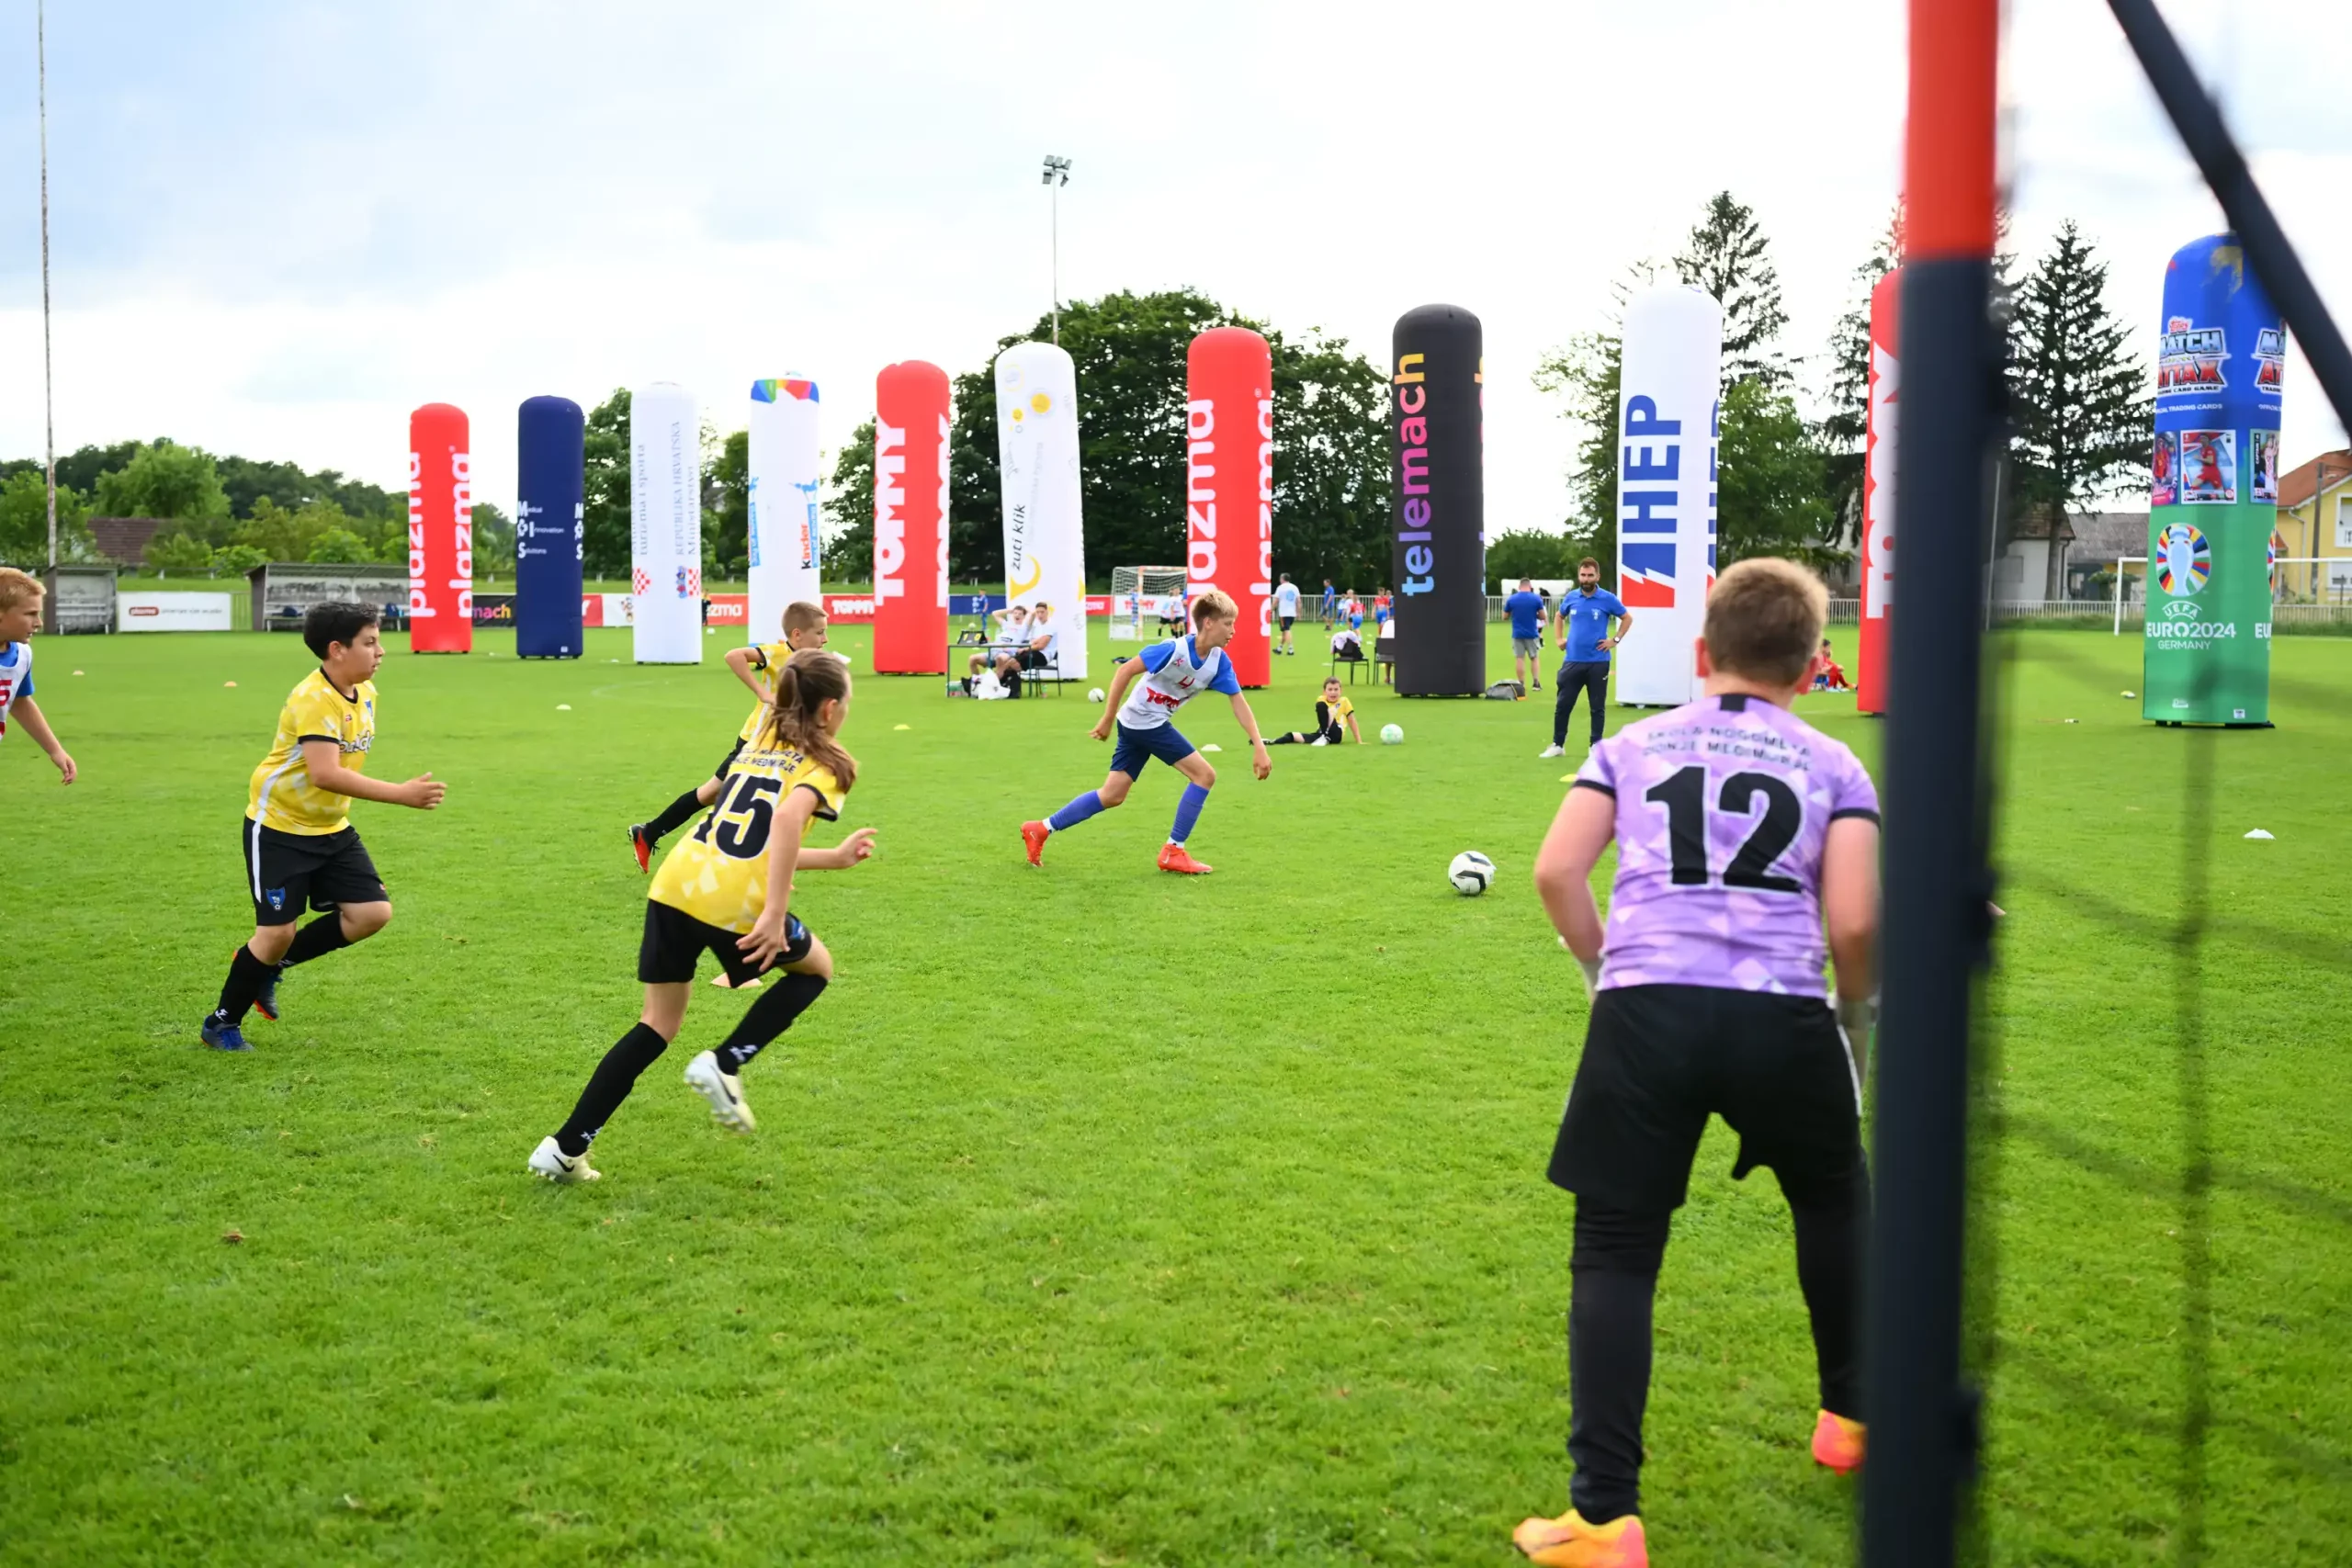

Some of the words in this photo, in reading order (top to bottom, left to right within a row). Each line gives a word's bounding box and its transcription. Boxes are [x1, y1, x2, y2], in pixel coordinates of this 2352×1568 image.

[637, 444, 649, 489] sporta
[671, 421, 683, 484] HRVATSKA
[1394, 354, 1435, 596] telemach
[1622, 395, 1681, 534] HEP
[639, 501, 648, 556] turizma
[674, 488, 684, 556] REPUBLIKA
[875, 413, 906, 606] TOMMY
[1012, 503, 1026, 535] klik
[2165, 604, 2198, 618] UEFA
[2157, 640, 2211, 649] GERMANY
[693, 773, 783, 859] 15
[1645, 765, 1802, 893] 12
